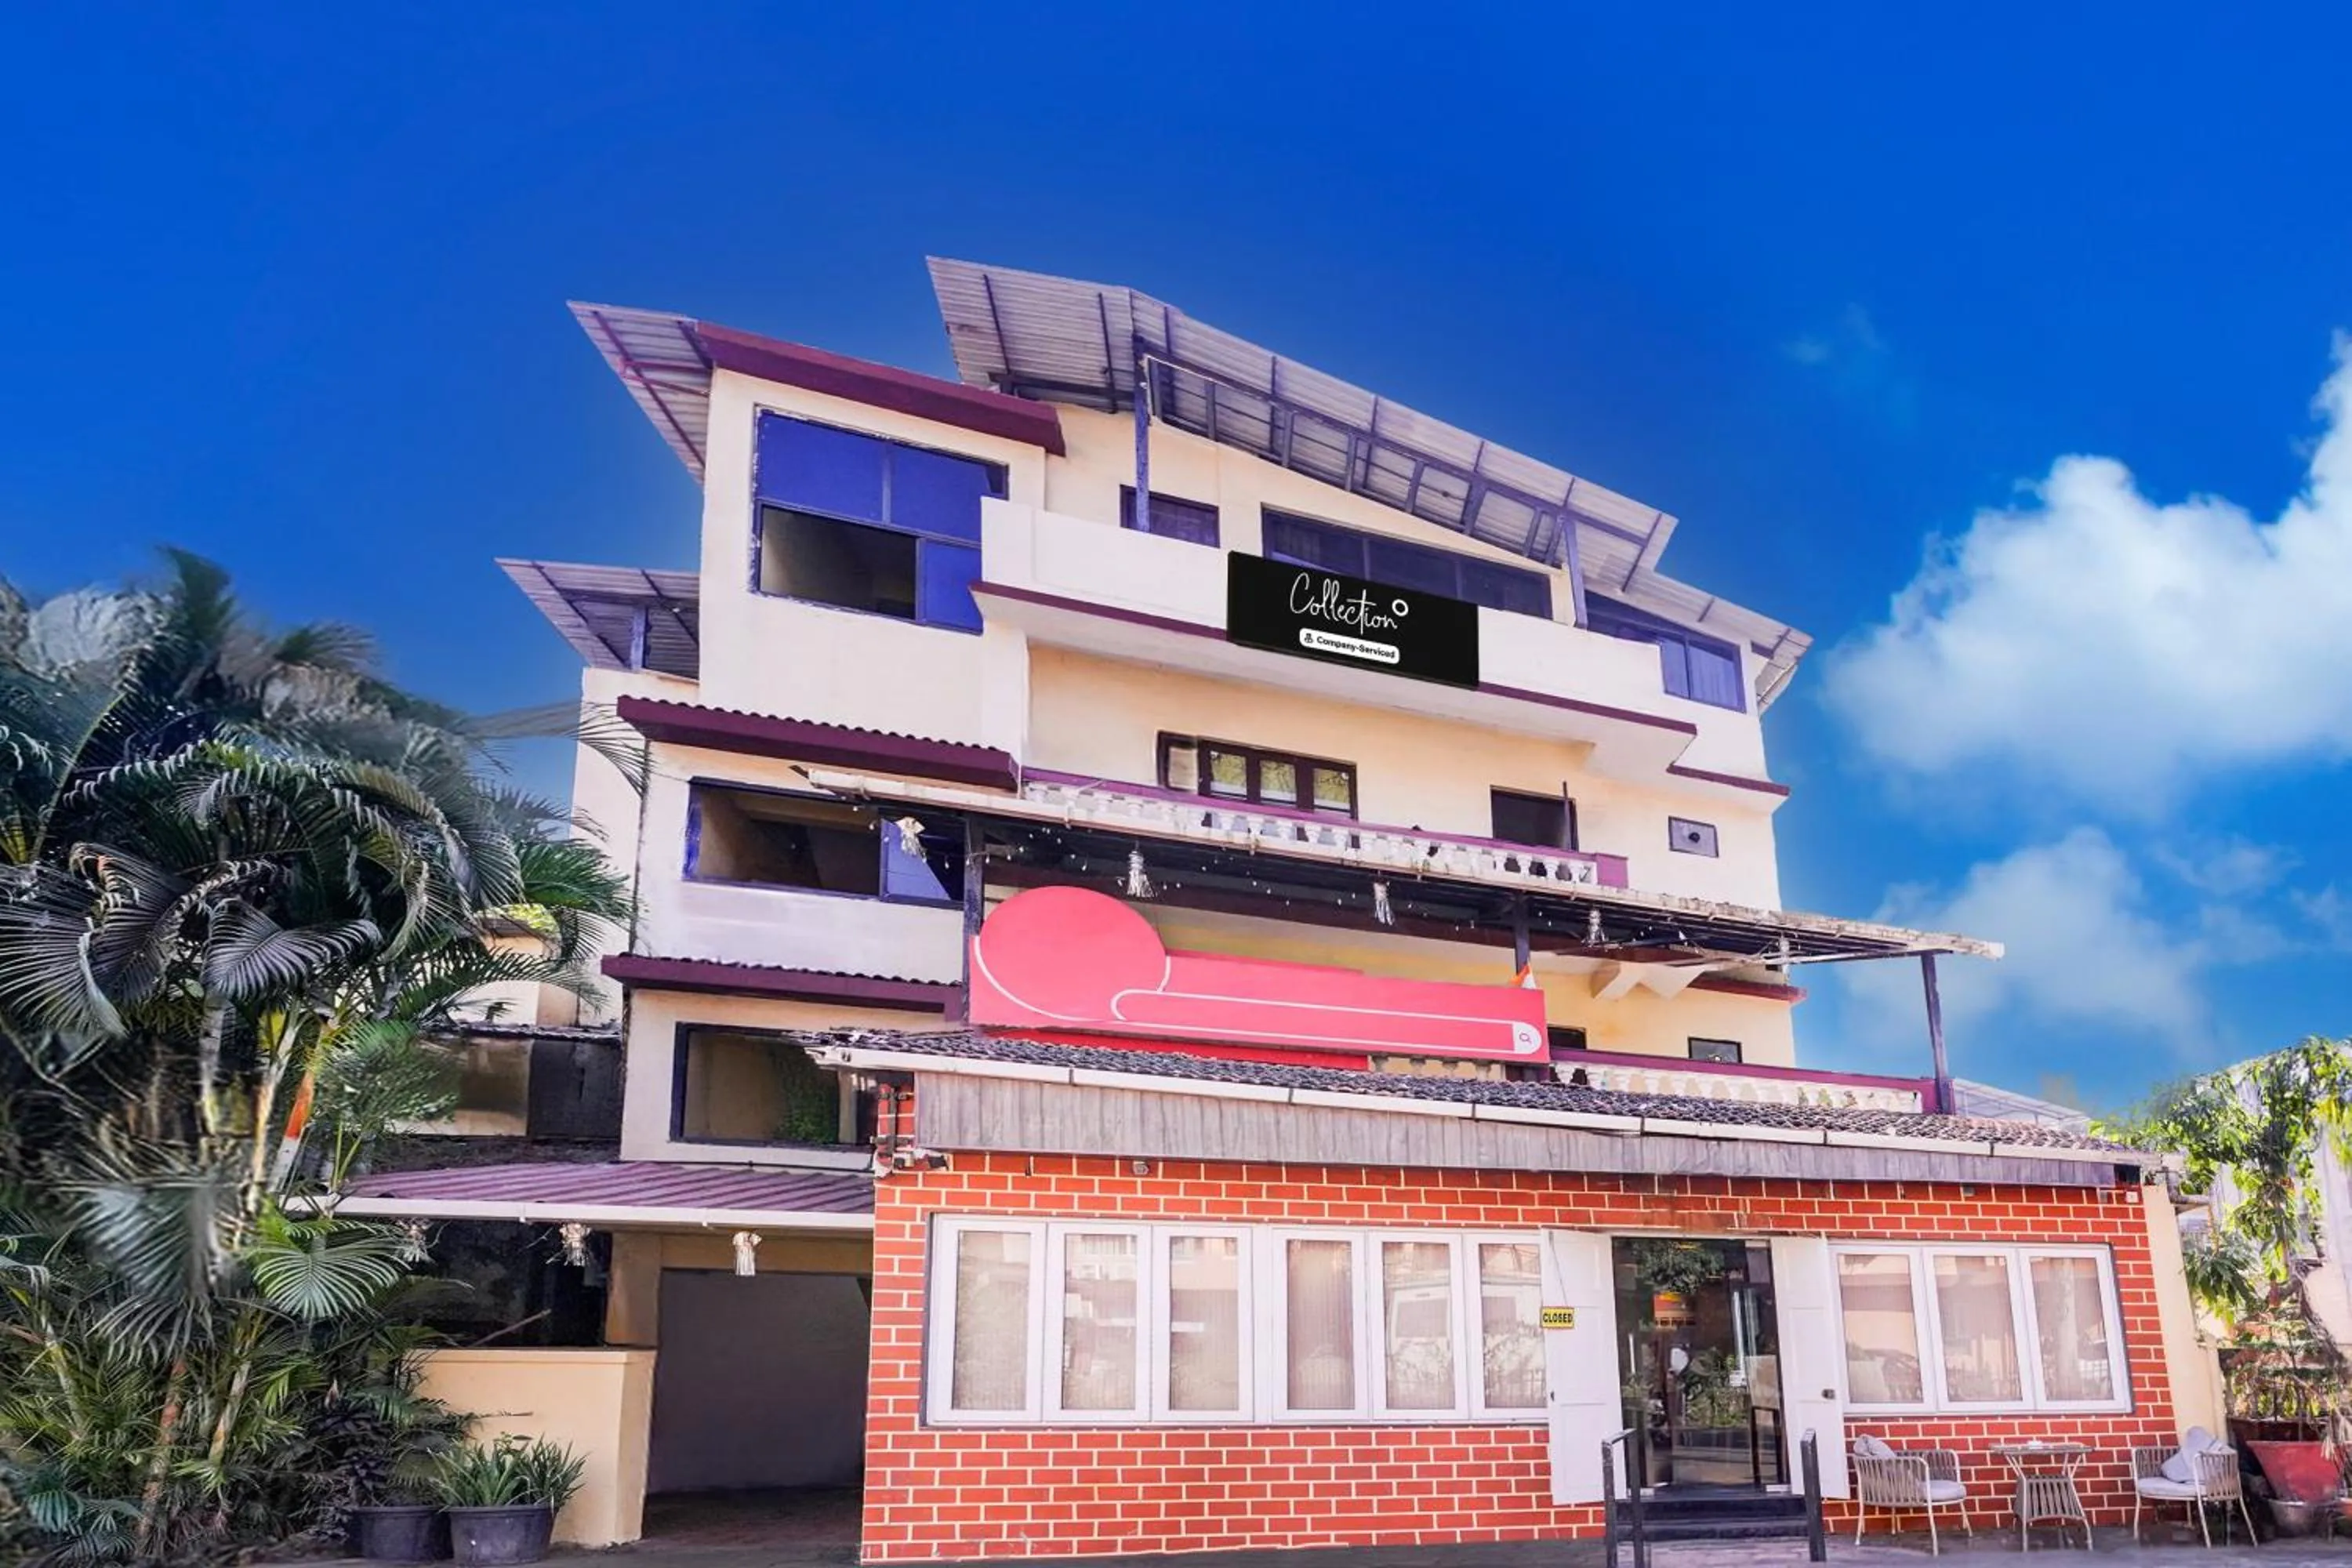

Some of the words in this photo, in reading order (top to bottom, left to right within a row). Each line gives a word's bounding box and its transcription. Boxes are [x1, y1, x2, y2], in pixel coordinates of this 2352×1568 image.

[1290, 572, 1397, 635] Collection
[1316, 636, 1396, 659] Company-Serviced
[1542, 1312, 1573, 1323] CLOSED
